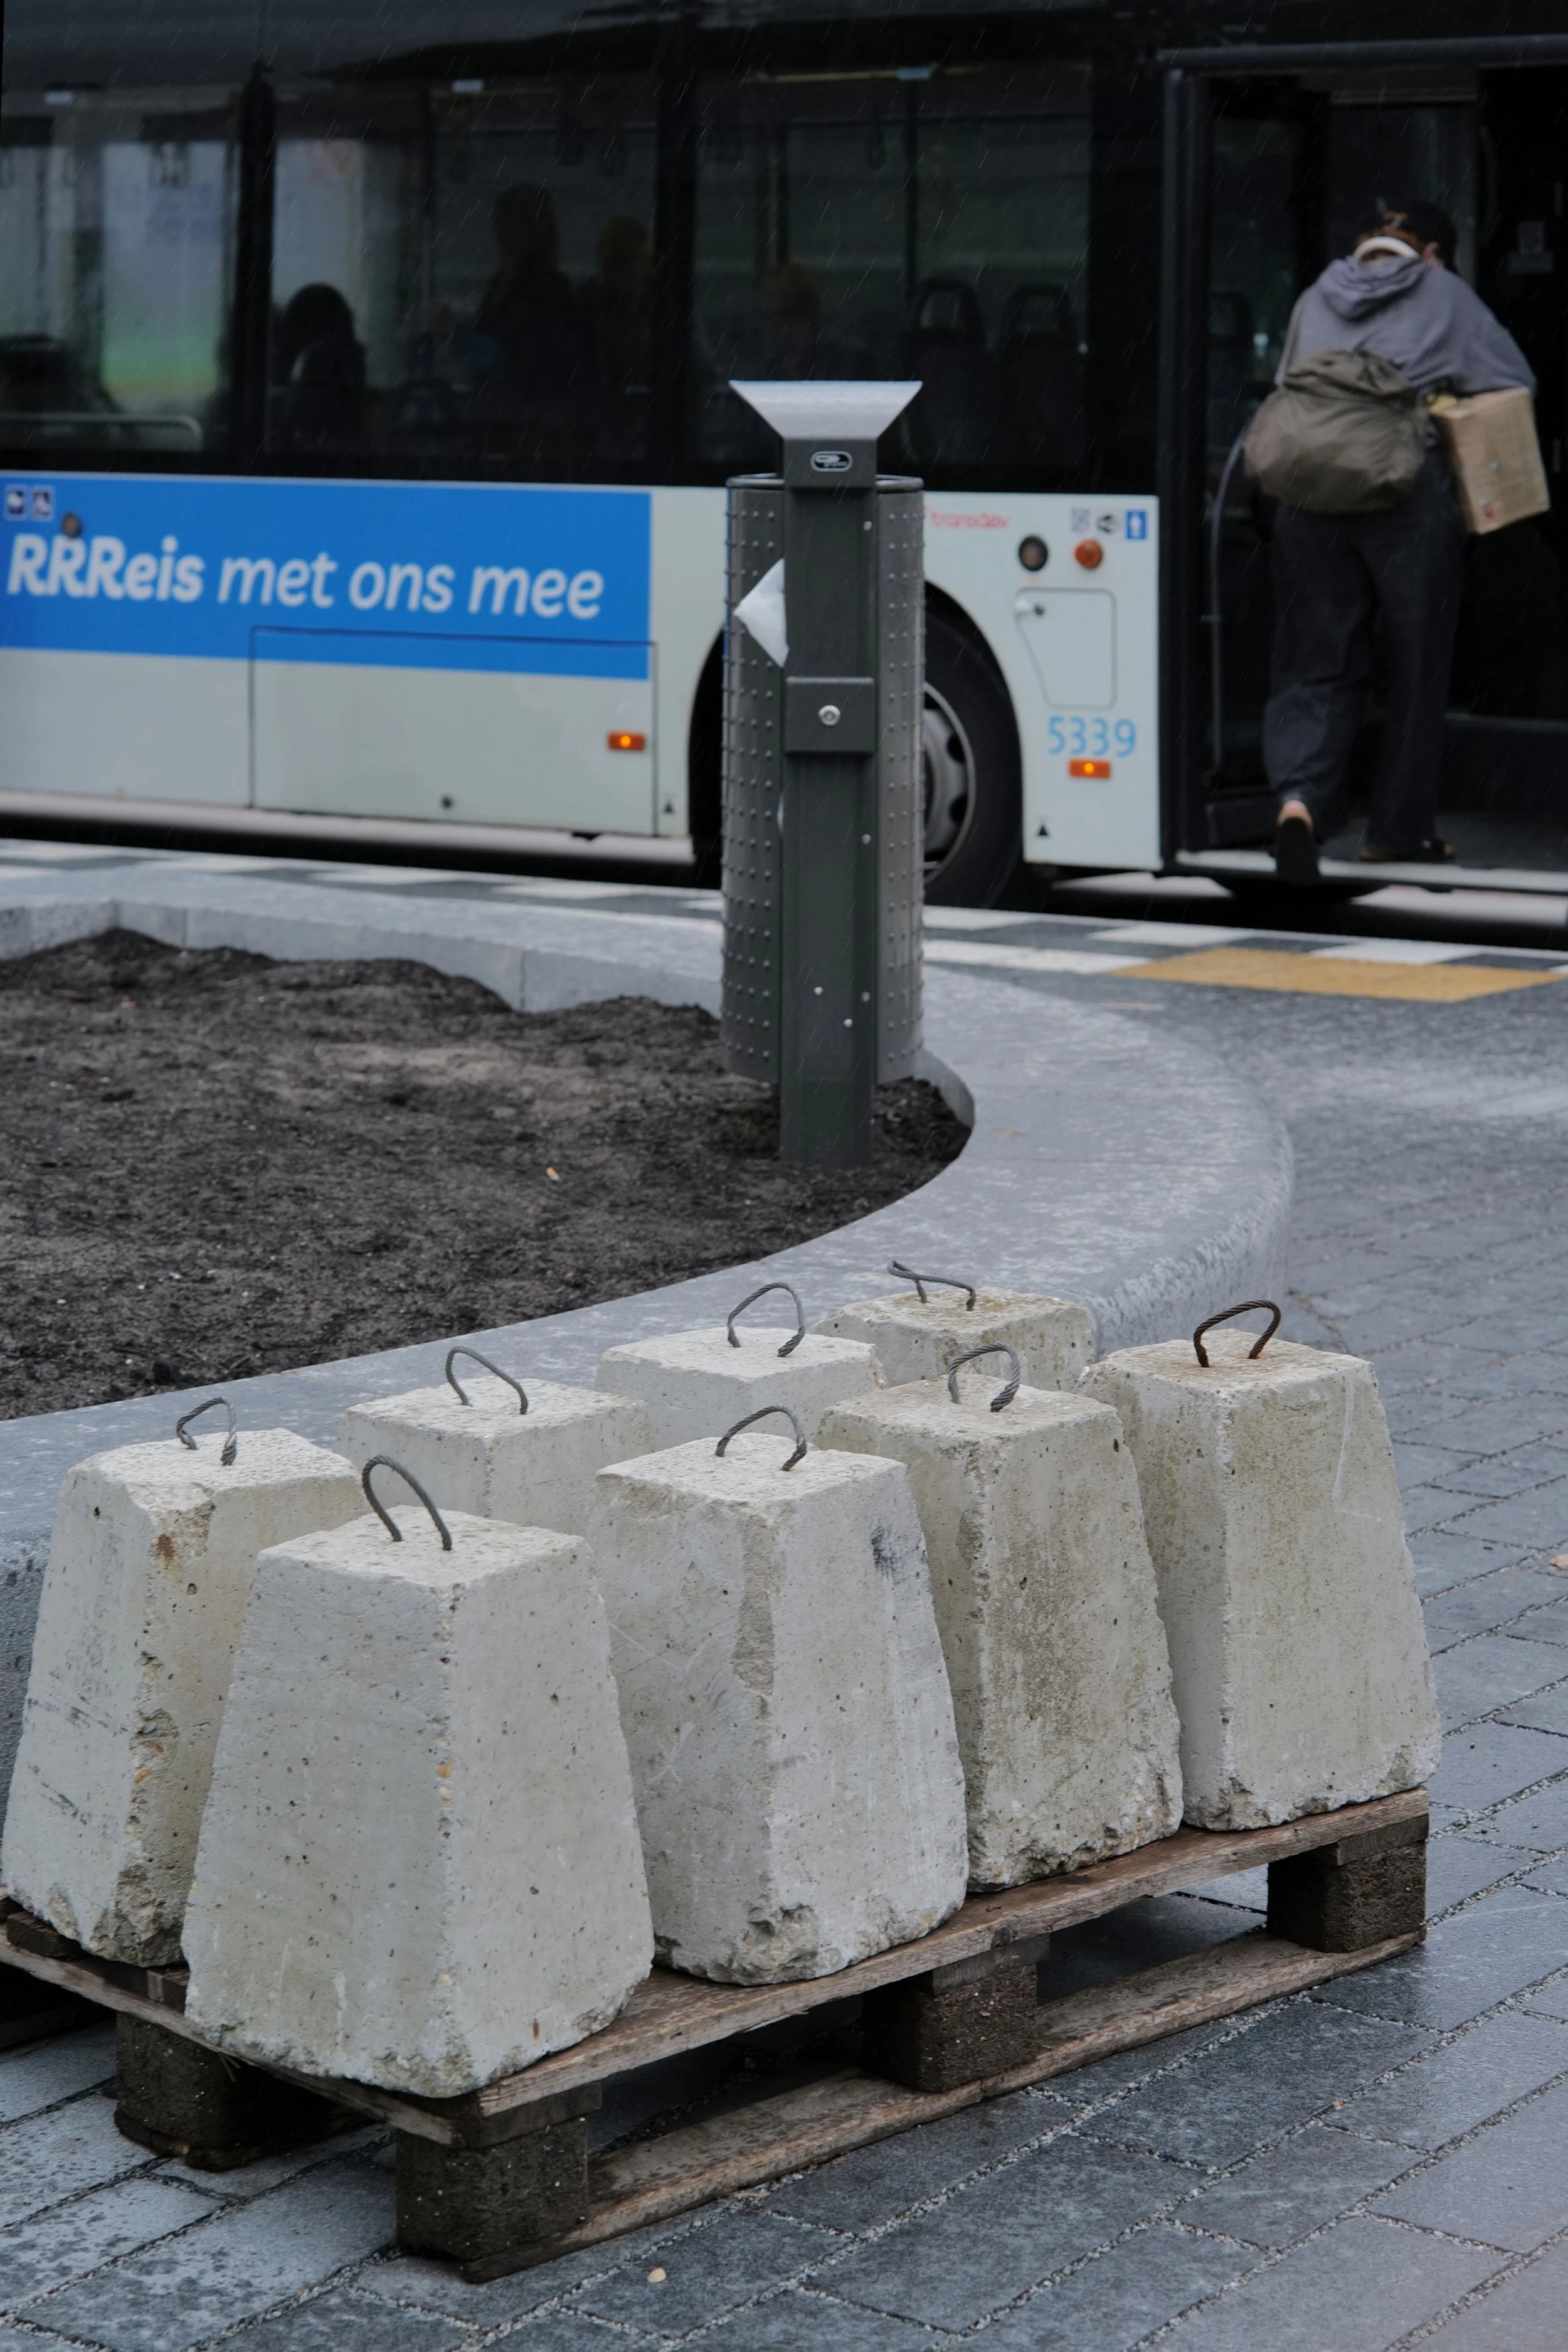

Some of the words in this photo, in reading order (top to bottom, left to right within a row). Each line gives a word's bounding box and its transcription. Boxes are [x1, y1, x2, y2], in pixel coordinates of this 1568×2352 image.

[6, 532, 204, 603] RRReis
[218, 552, 337, 607] met
[349, 562, 455, 613] ons
[468, 566, 603, 619] mee
[1047, 716, 1136, 757] 5339
